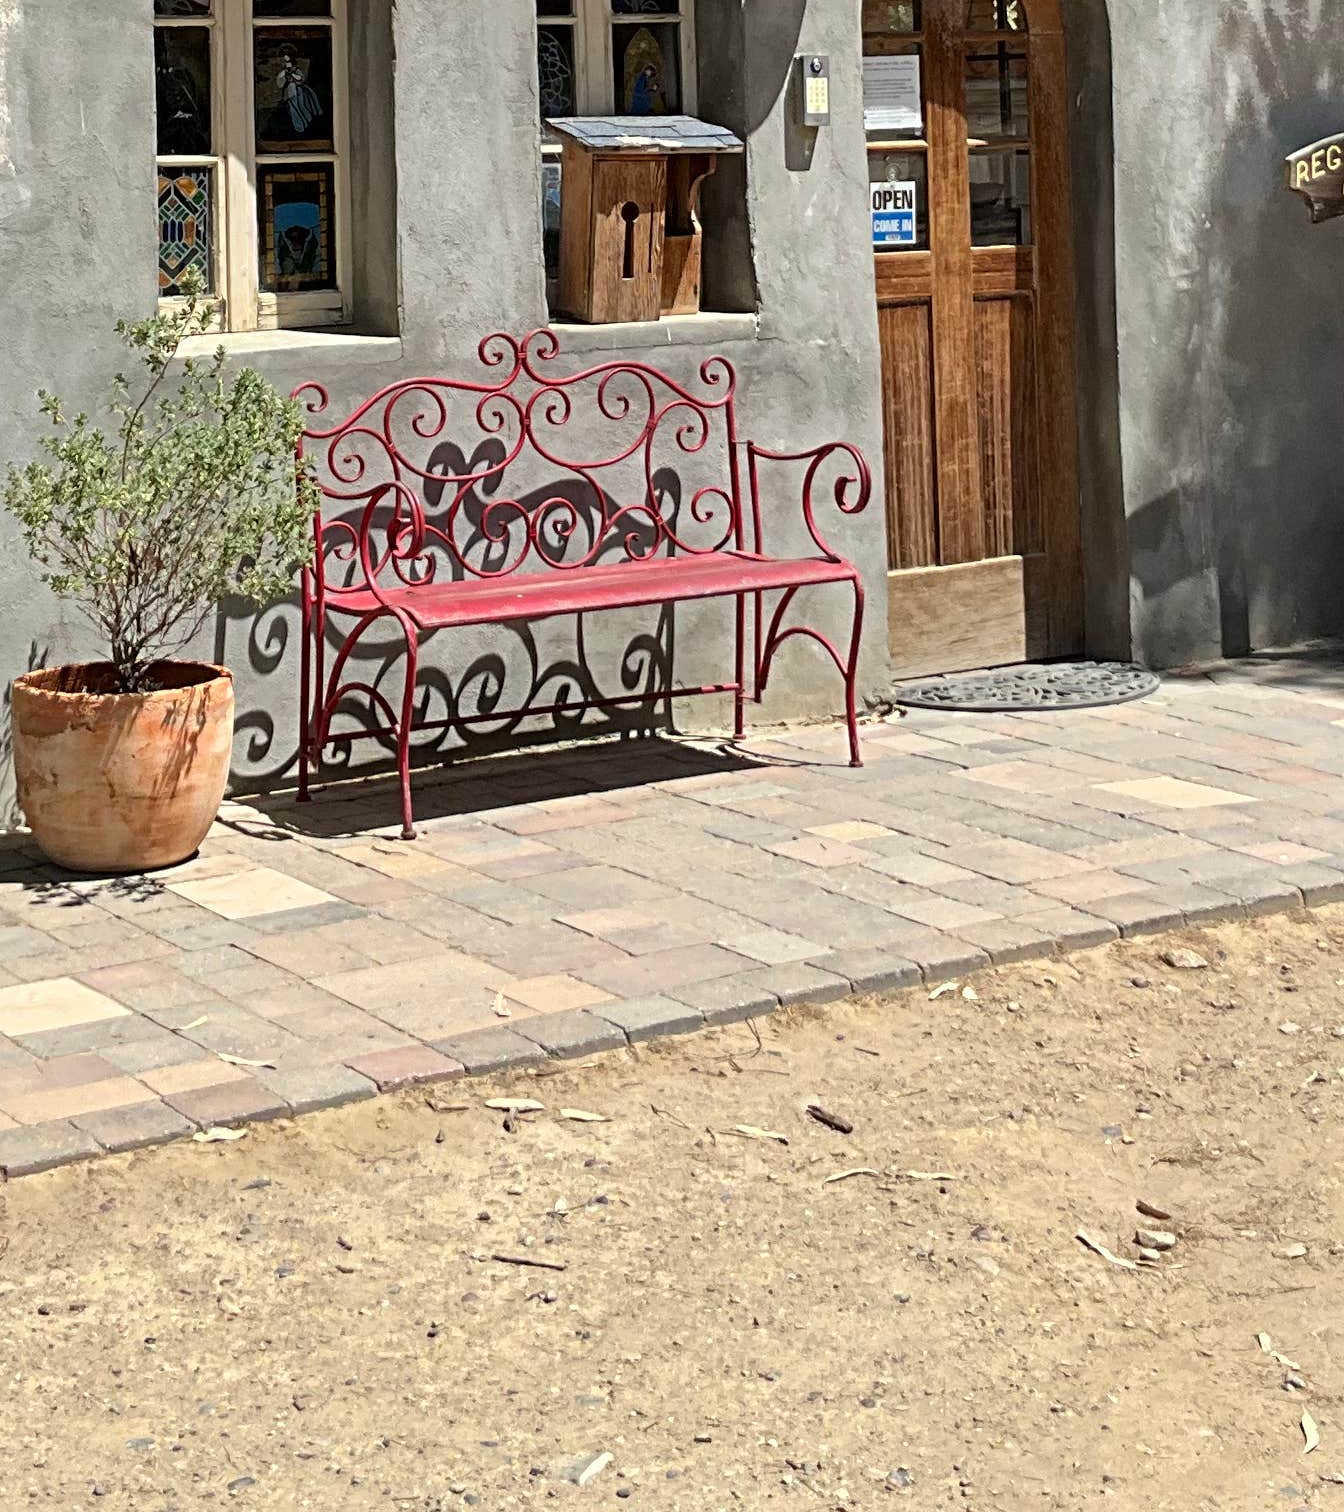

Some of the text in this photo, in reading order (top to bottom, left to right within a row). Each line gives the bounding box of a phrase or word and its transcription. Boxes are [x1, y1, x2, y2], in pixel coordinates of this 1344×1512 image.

[872, 189, 913, 210] OPEN
[873, 218, 912, 232] COME IN
